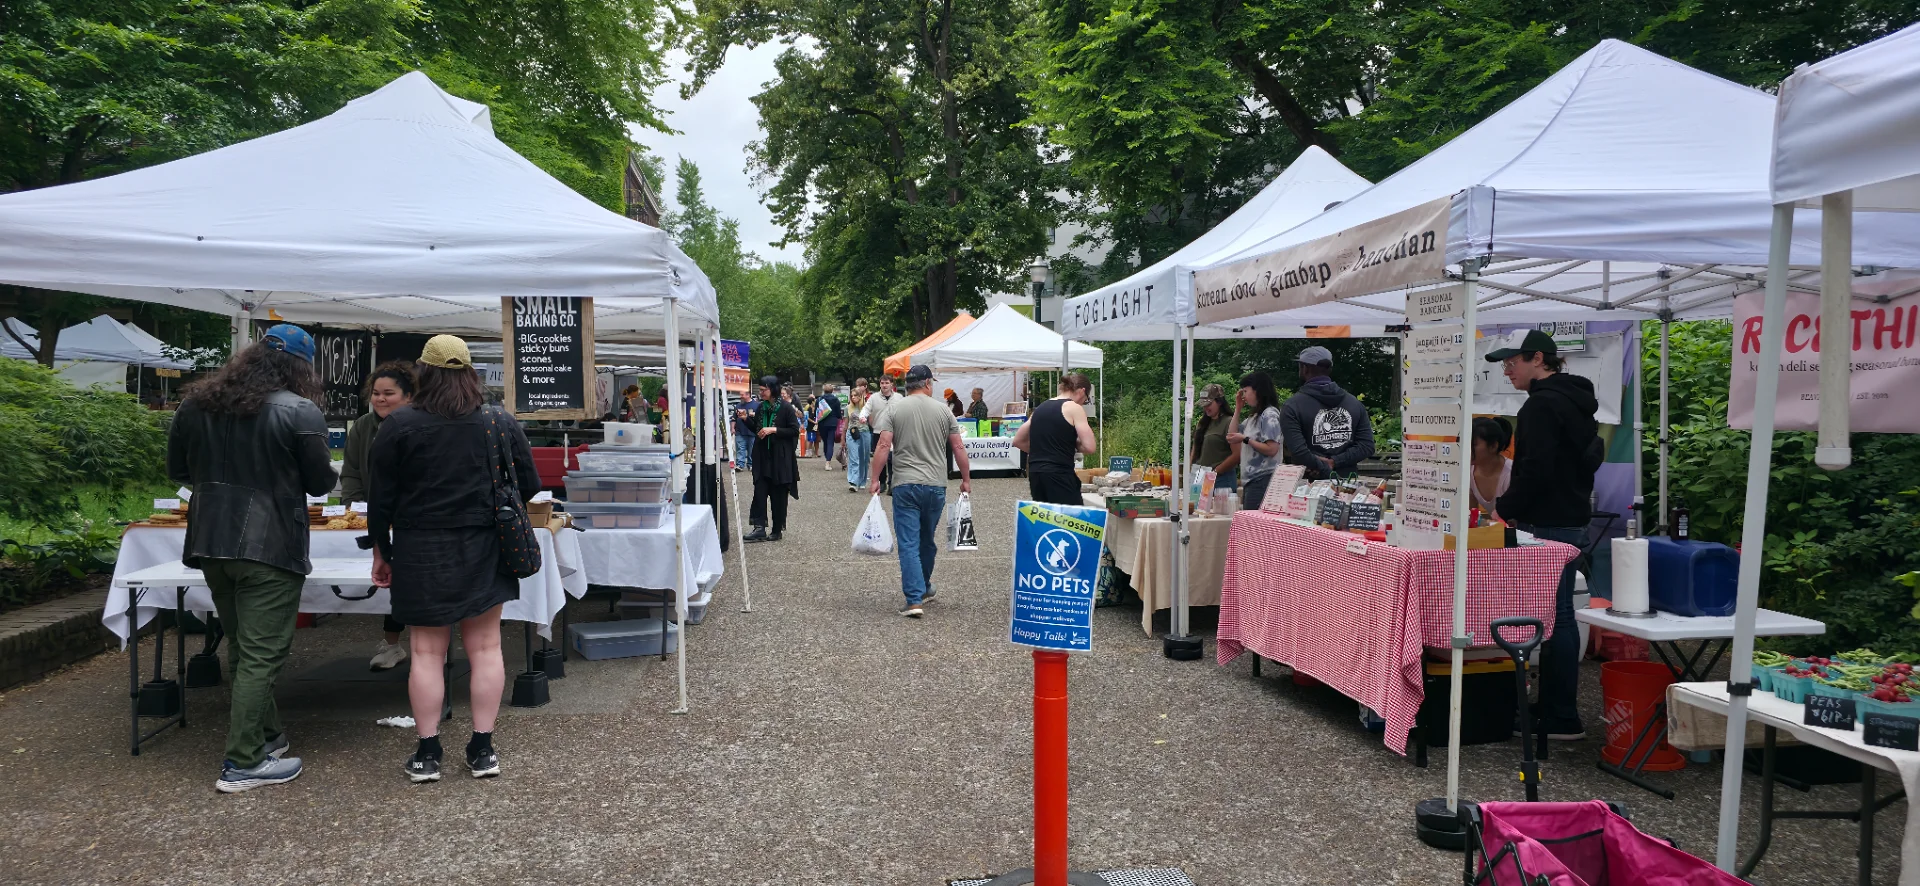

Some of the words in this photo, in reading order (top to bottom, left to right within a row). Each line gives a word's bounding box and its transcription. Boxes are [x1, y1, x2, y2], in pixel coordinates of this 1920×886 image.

[1196, 283, 1228, 310] korean
[1230, 274, 1257, 301] food
[1270, 260, 1332, 298] gimbap
[1351, 229, 1436, 272] banchan
[1420, 292, 1453, 305] SEASONAL
[514, 296, 577, 315] SMALL
[1420, 303, 1452, 316] BANCHAN
[516, 314, 558, 327] BAKING
[559, 314, 577, 327] CO.
[538, 333, 572, 343] cookies
[1454, 334, 1463, 343] 12
[549, 344, 569, 352] buns
[554, 364, 572, 372] cake
[1786, 361, 1807, 371] deli
[522, 375, 531, 384] &
[532, 376, 555, 384] more
[1410, 415, 1424, 424] DELI
[1425, 415, 1456, 425] COUNTER
[986, 441, 1011, 449] Ready
[1441, 500, 1450, 509] 10
[1030, 506, 1051, 521] Pet
[1053, 513, 1101, 539] Crossing
[1018, 573, 1046, 590] NO
[1051, 576, 1090, 594] PETS
[1013, 626, 1041, 641] Happy
[1044, 630, 1067, 642] Tails!
[1810, 695, 1842, 708] PEAS
